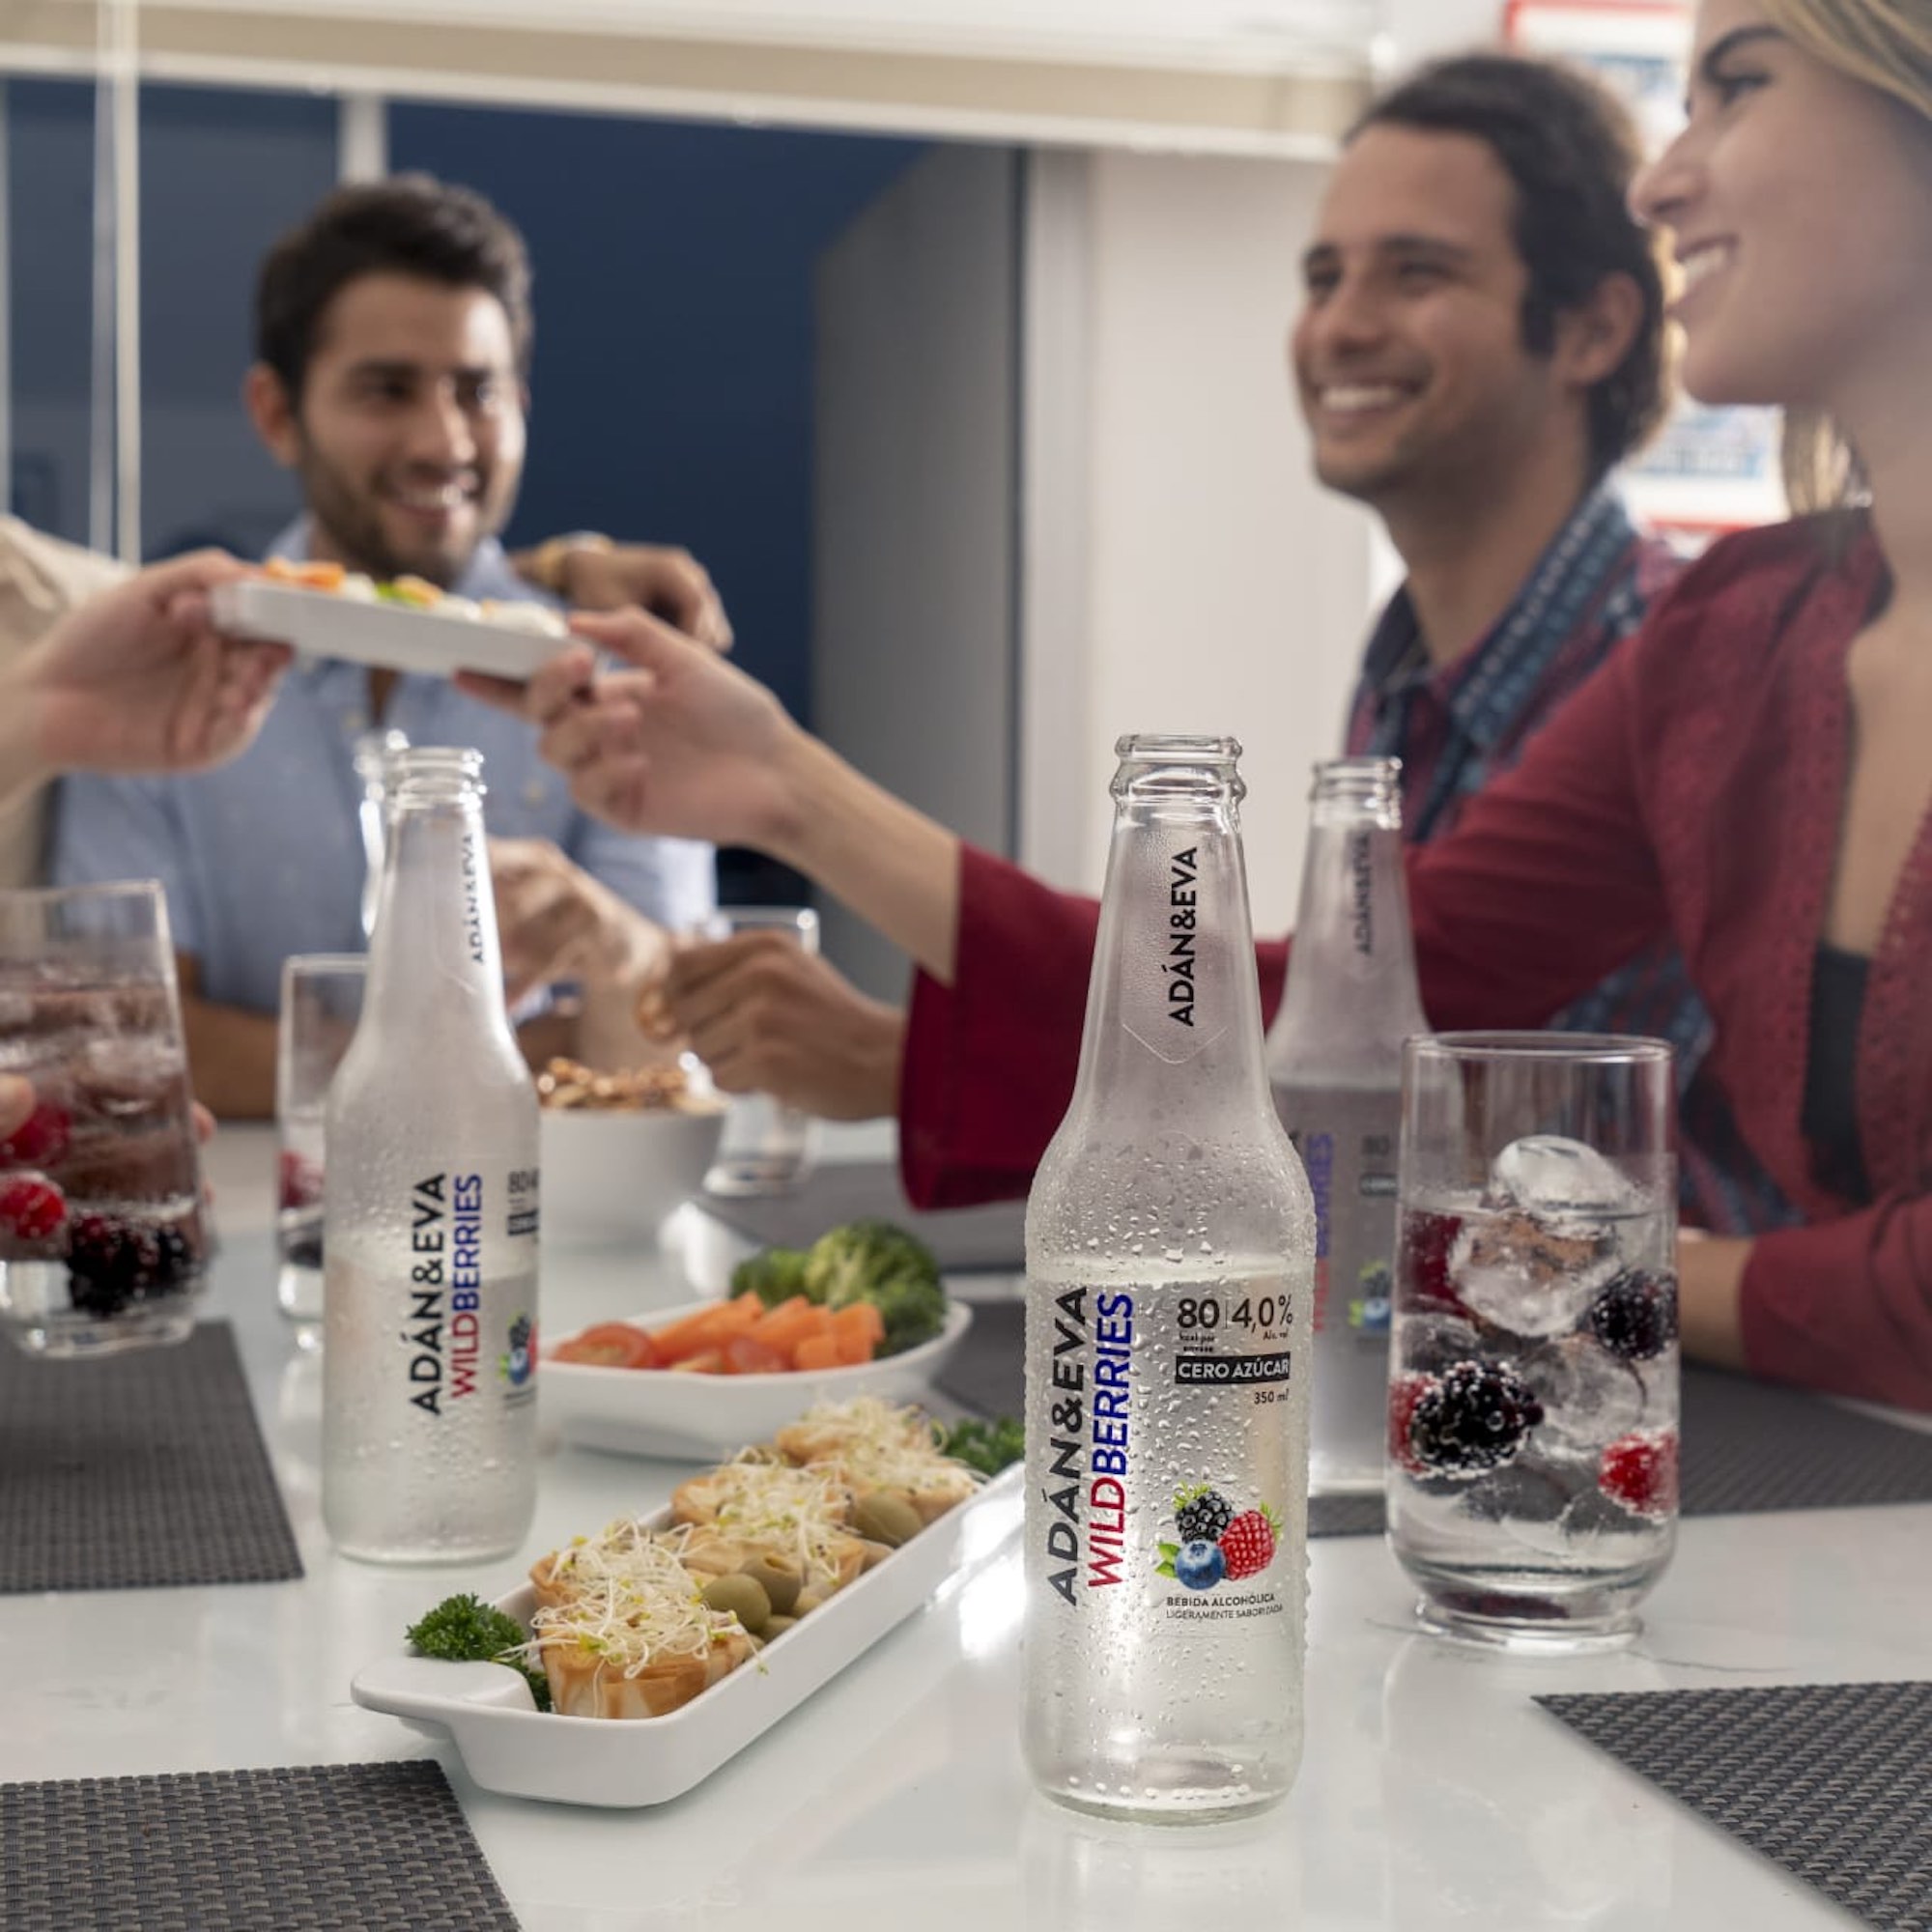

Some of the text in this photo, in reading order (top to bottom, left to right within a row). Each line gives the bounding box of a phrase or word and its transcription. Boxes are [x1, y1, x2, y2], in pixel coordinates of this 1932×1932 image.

[1161, 846, 1198, 1027] ADÁN&EVA
[398, 1173, 446, 1415] ADÁN&EVA
[449, 1174, 483, 1399] WILDBERRIES
[1177, 1297, 1220, 1328] 80
[1232, 1294, 1293, 1333] 4,0%
[1178, 1357, 1290, 1379] CERO AZÚCAR
[1254, 1390, 1275, 1406] 350
[1041, 1287, 1088, 1607] ADÁN&EVA
[1088, 1293, 1134, 1587] WILDBERRIES
[1166, 1596, 1209, 1606] BEBIDA
